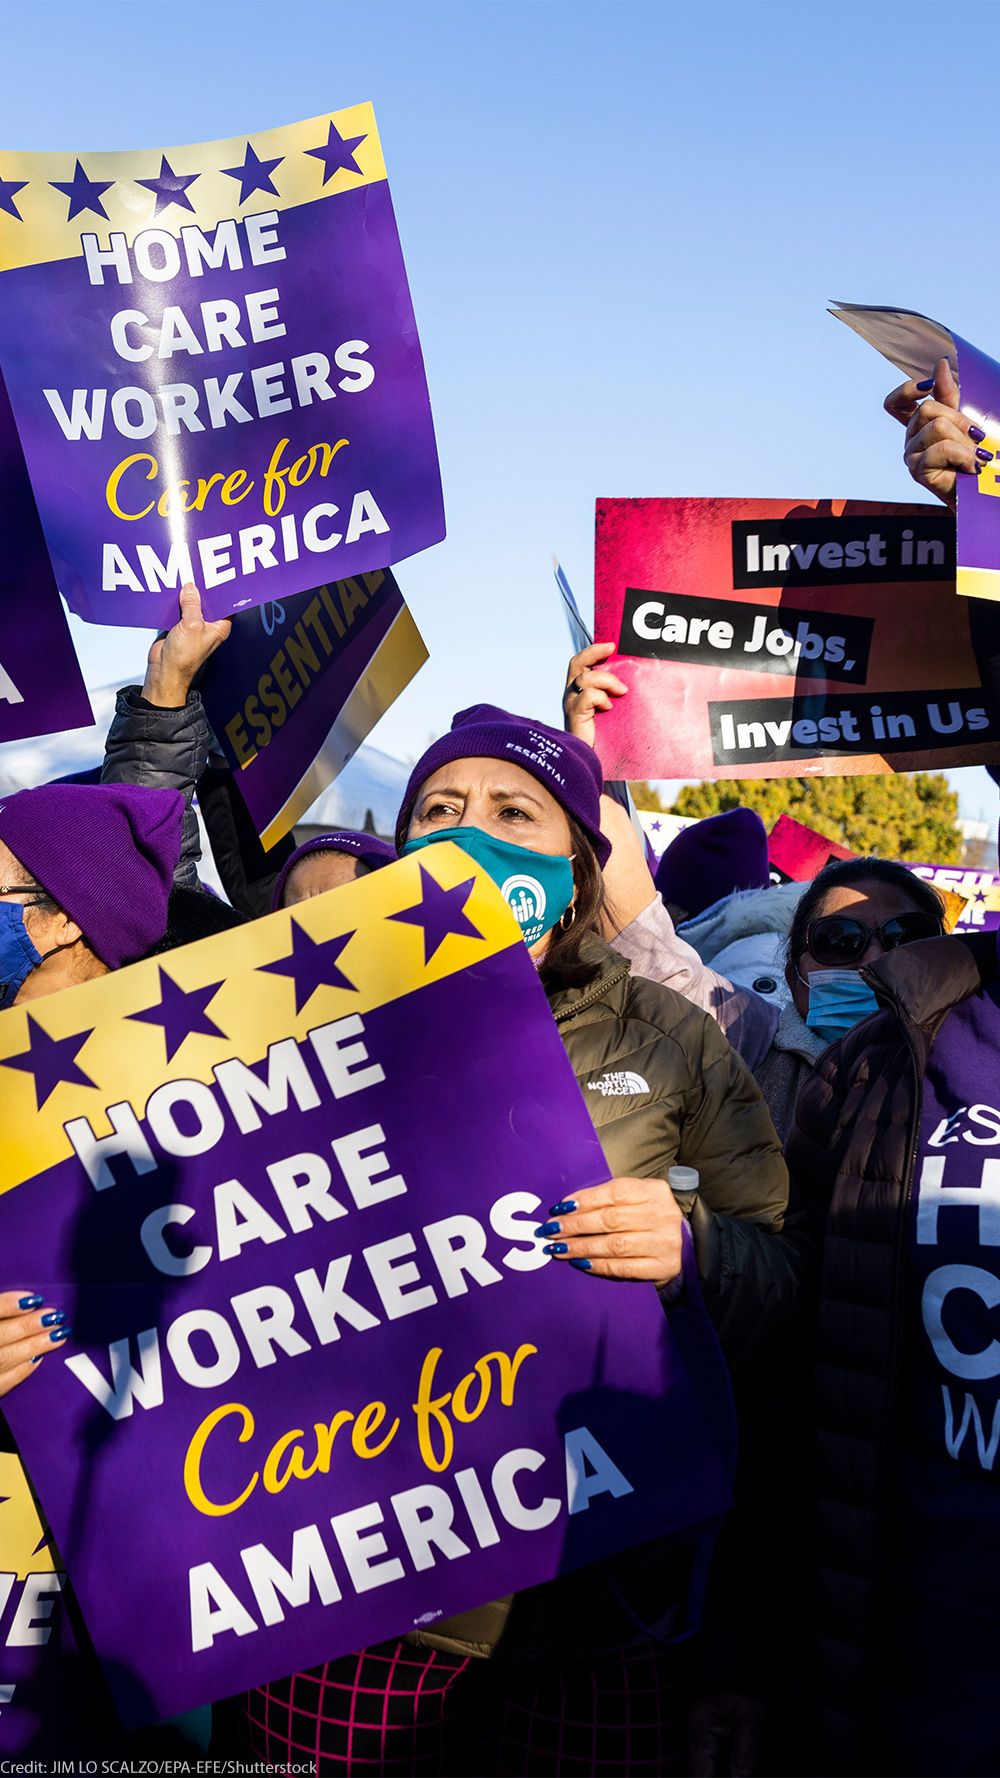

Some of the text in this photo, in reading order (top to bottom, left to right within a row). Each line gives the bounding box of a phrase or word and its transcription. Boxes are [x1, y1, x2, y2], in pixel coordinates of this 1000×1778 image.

[81, 210, 287, 285] HOME
[110, 288, 287, 362] CARE
[43, 339, 375, 441] WORKERS
[105, 437, 349, 521] Care for
[102, 489, 390, 594] AMERICA
[746, 529, 945, 573] Invest in
[224, 569, 386, 771] ESSENTIAL
[631, 601, 856, 671] Care Jobs,
[719, 701, 990, 751] Invest in Us
[64, 1013, 387, 1191] HOME
[587, 1078, 628, 1090] NORTH
[601, 1087, 630, 1096] FACE
[602, 1072, 626, 1082] THE
[140, 1123, 408, 1278] CARE
[65, 1191, 555, 1421] WORKERS
[184, 1343, 538, 1516] Care for
[189, 1426, 635, 1653] AMERICA
